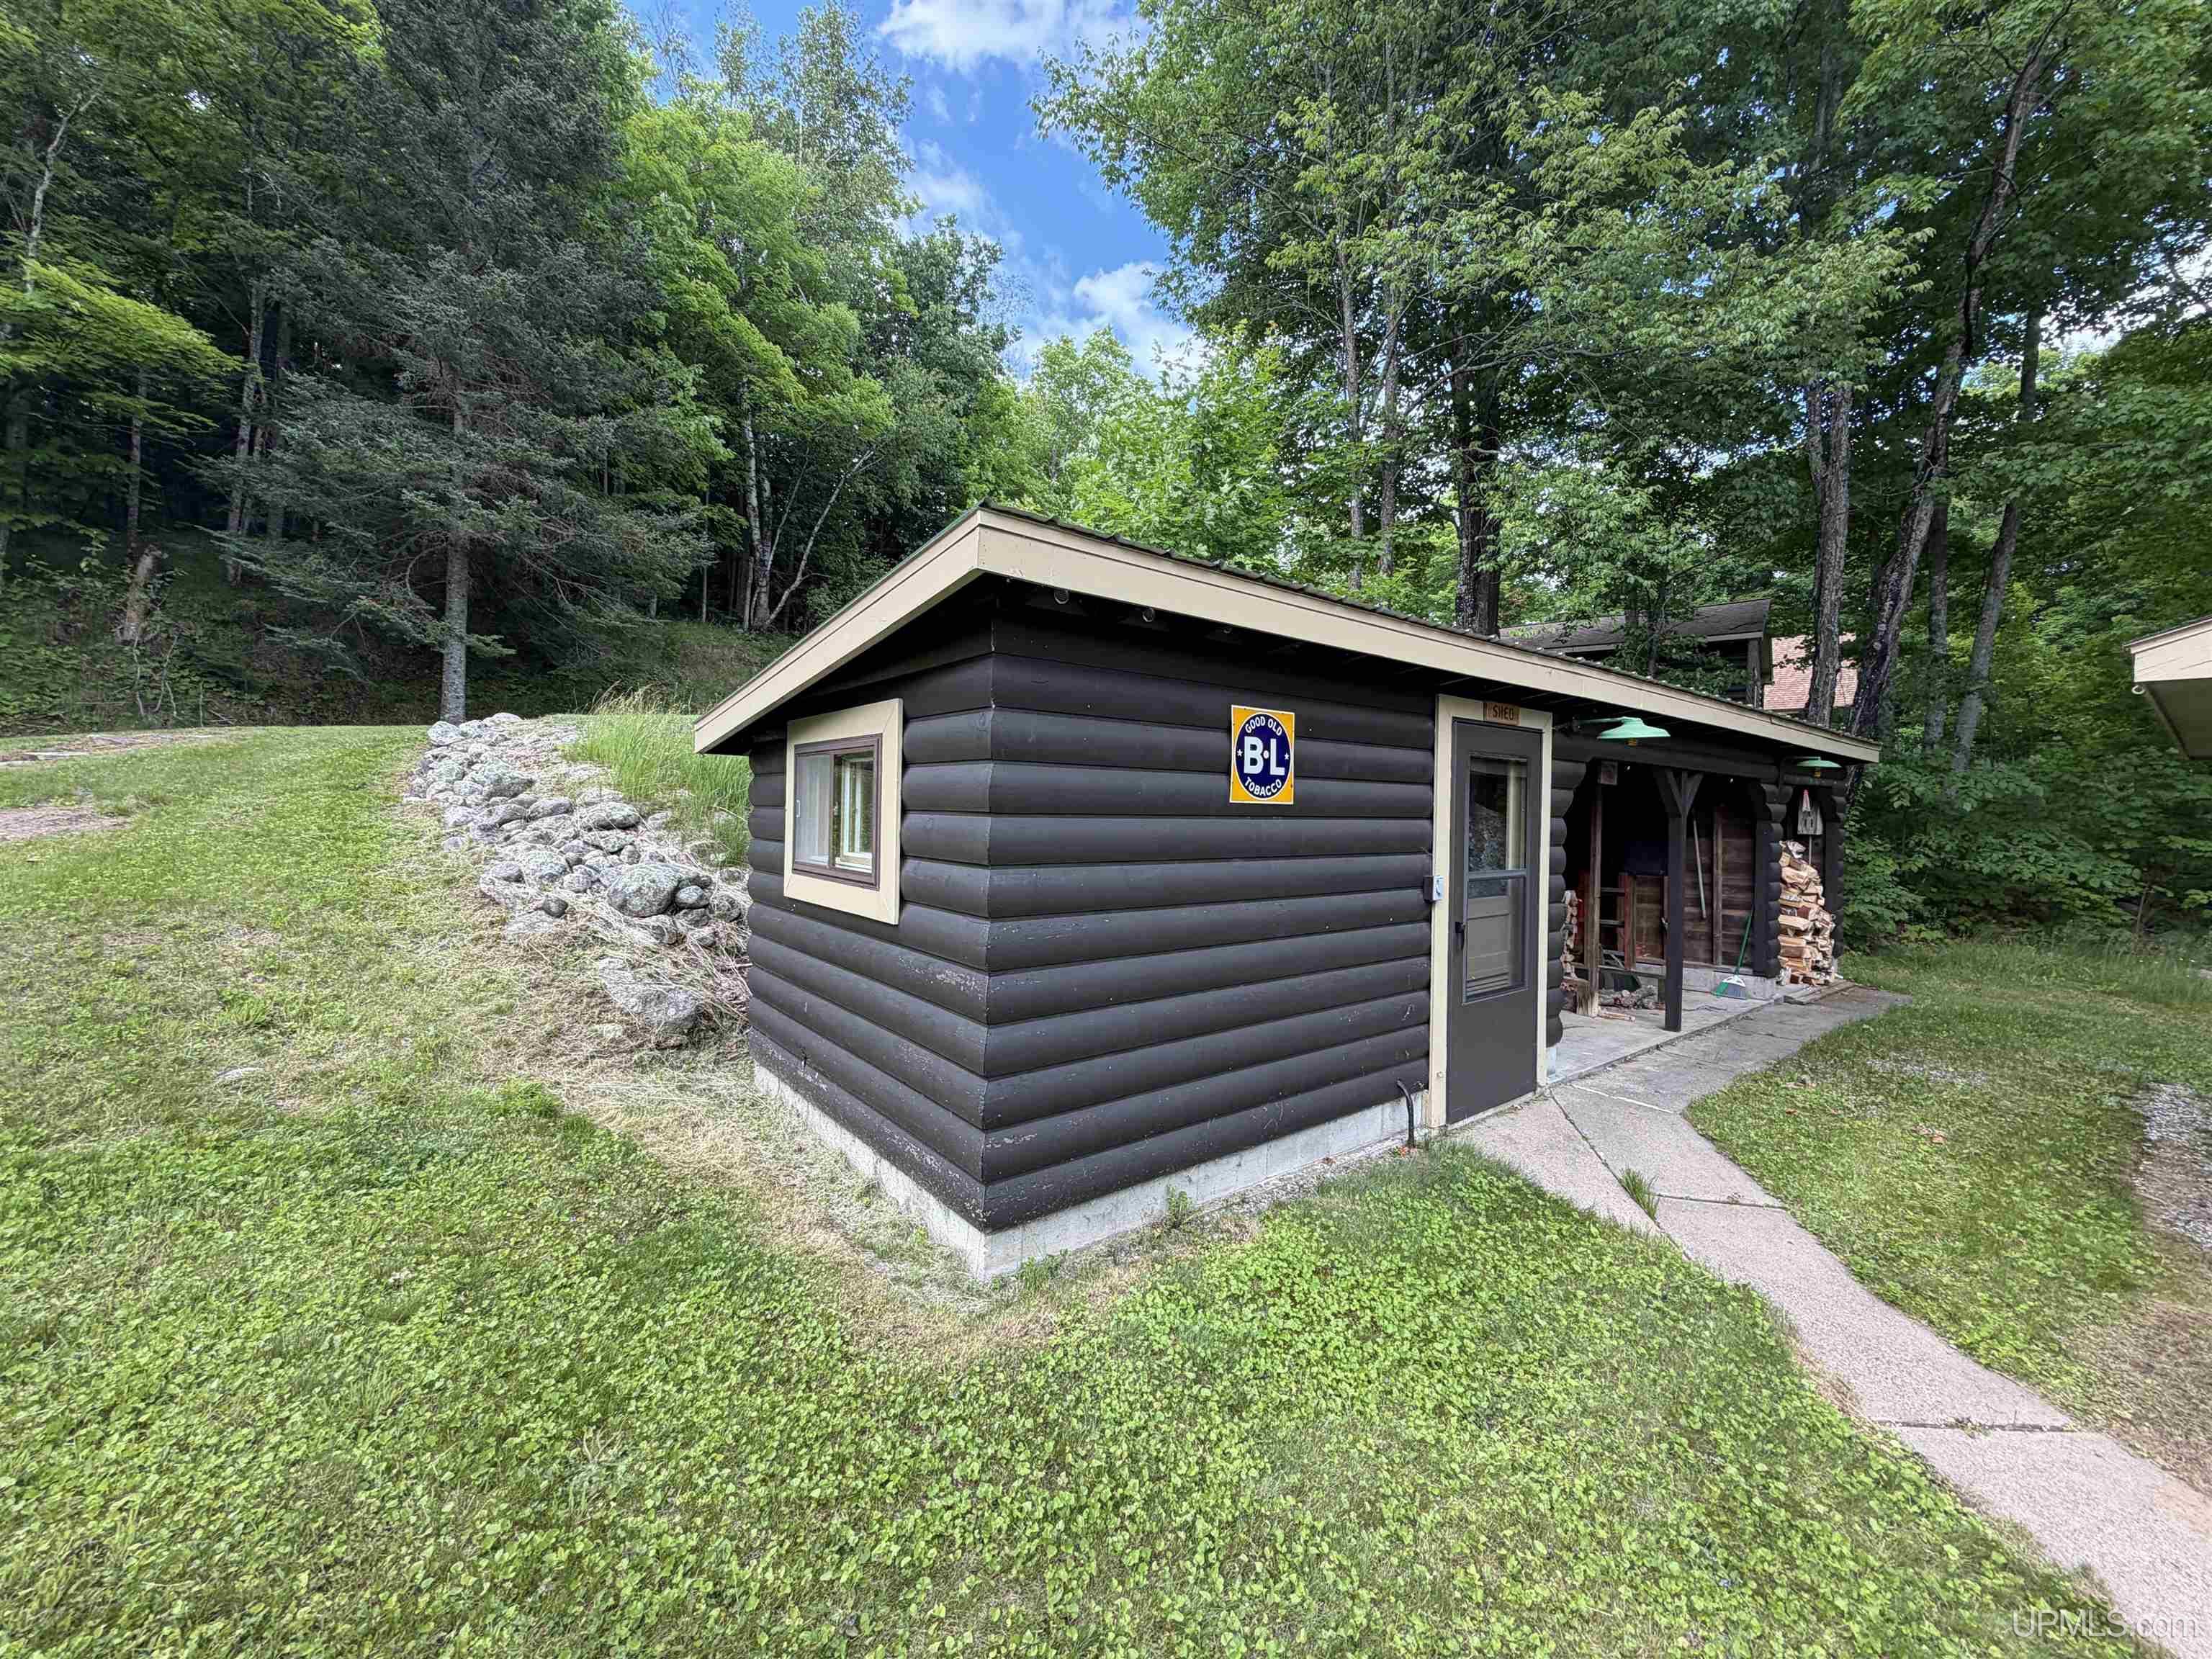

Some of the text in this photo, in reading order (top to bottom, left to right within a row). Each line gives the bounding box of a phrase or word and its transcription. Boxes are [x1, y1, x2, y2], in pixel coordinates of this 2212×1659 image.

[1492, 705, 1514, 721] SHED
[1245, 716, 1282, 736] GOOD OLD
[1244, 776, 1282, 796] TOBACCO
